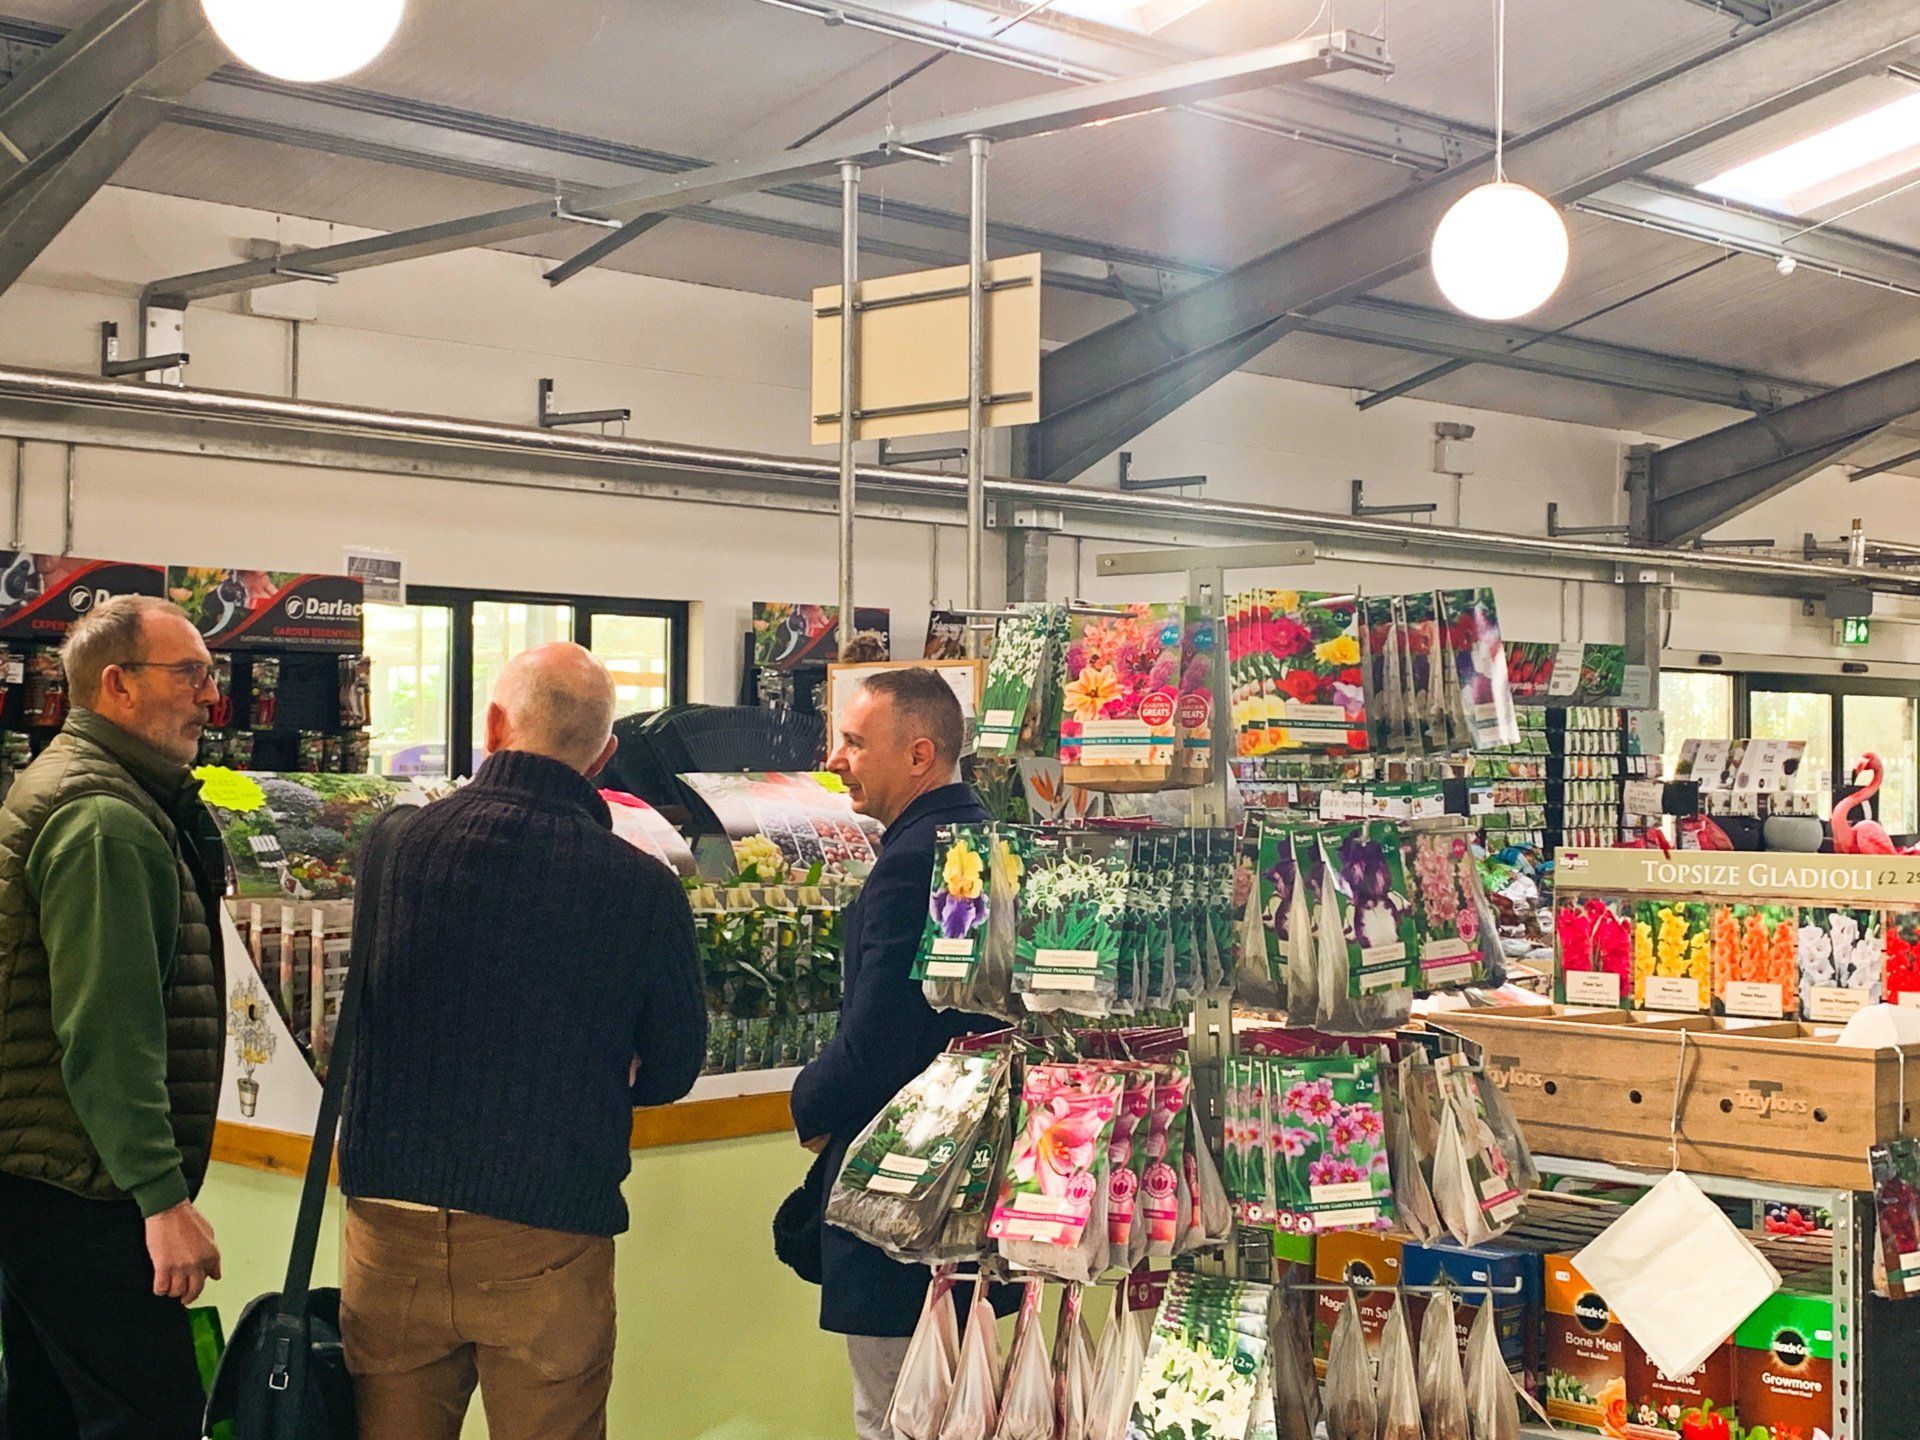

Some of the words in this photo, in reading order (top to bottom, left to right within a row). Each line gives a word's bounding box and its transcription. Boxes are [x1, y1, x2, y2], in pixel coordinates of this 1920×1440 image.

[305, 597, 362, 615] Darlac
[32, 619, 71, 630] EXPER
[273, 626, 310, 636] GARDEN
[312, 627, 361, 638] ESSENTIALS
[1142, 708, 1170, 717] GREATS
[1559, 856, 1590, 871] Taylors
[1641, 860, 1740, 886] TOPSIZE
[1748, 863, 1872, 890] GLADIOLI
[1026, 1092, 1043, 1101] NEW
[1735, 1089, 1808, 1115] Taylors
[936, 1144, 952, 1158] XL
[971, 1148, 991, 1164] XL
[1565, 1331, 1594, 1348] Bone
[1595, 1337, 1622, 1353] Meal
[1667, 1374, 1696, 1386] one
[1761, 1372, 1823, 1392] Growmore
